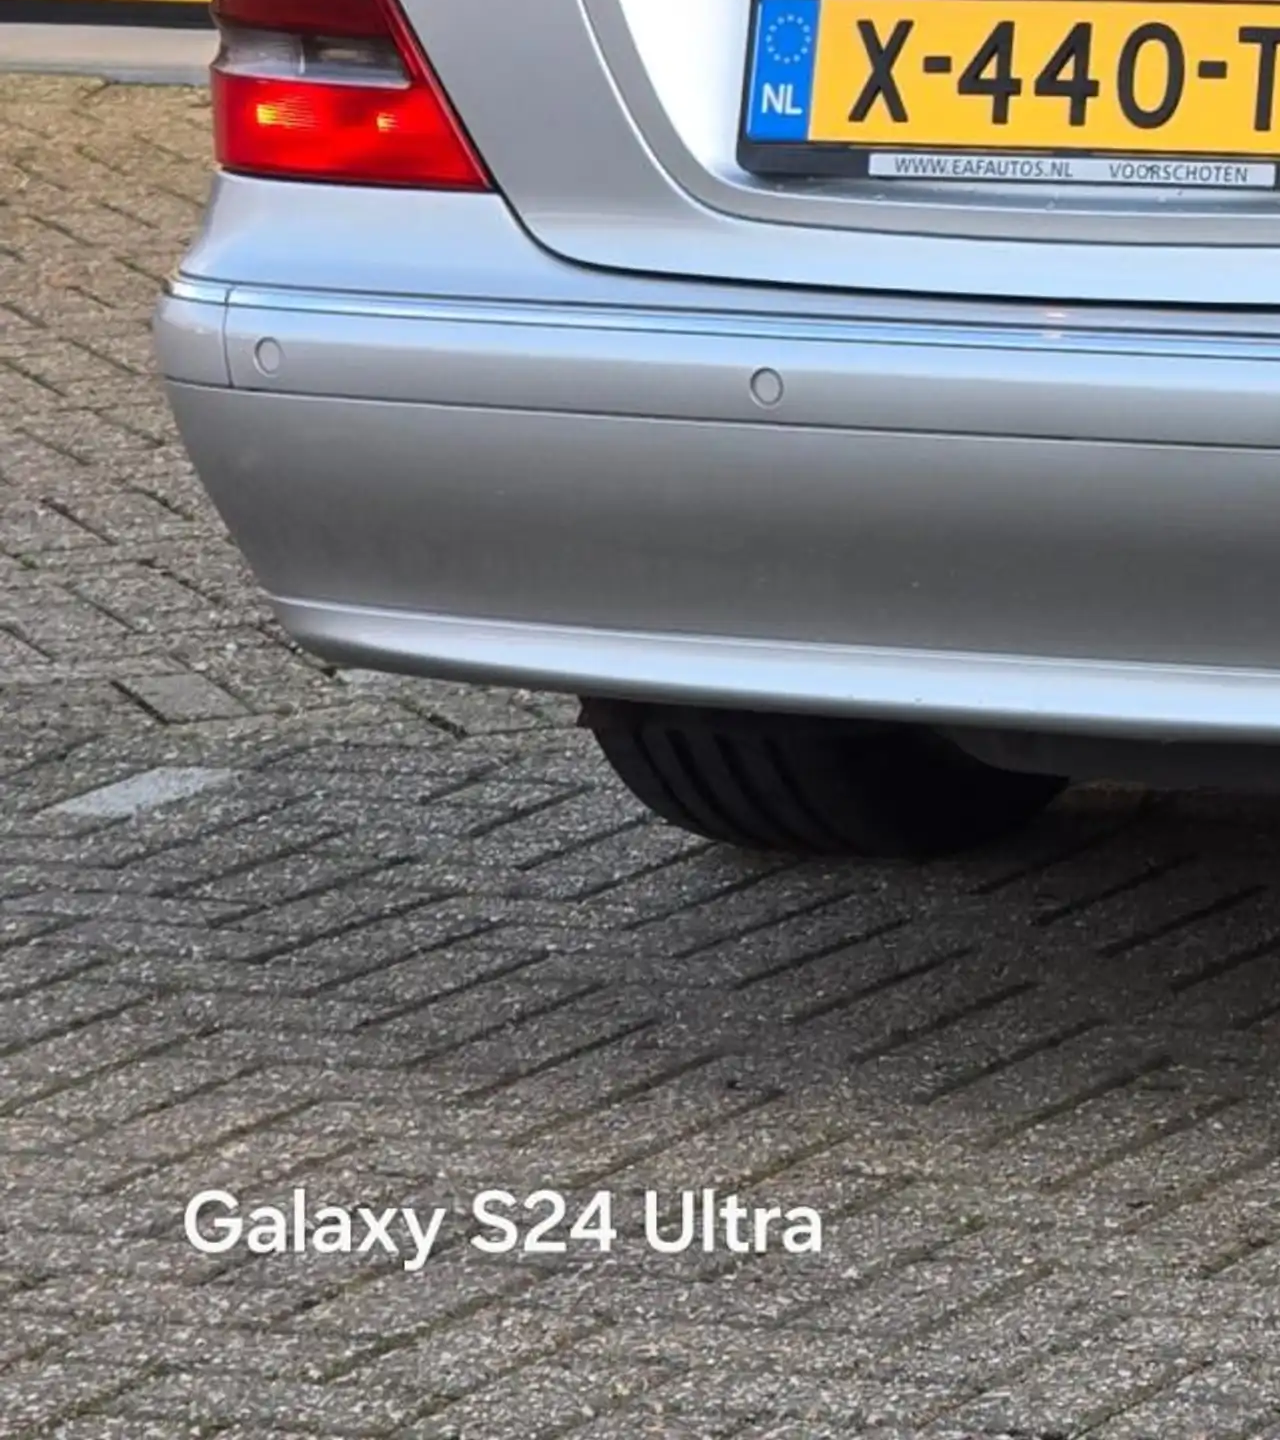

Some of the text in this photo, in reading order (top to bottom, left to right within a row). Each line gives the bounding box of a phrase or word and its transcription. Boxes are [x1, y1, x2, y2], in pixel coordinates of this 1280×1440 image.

[760, 82, 803, 116] NL
[894, 156, 1249, 184] WWW.EAFAUTOS.NL VOORSCHOTEN
